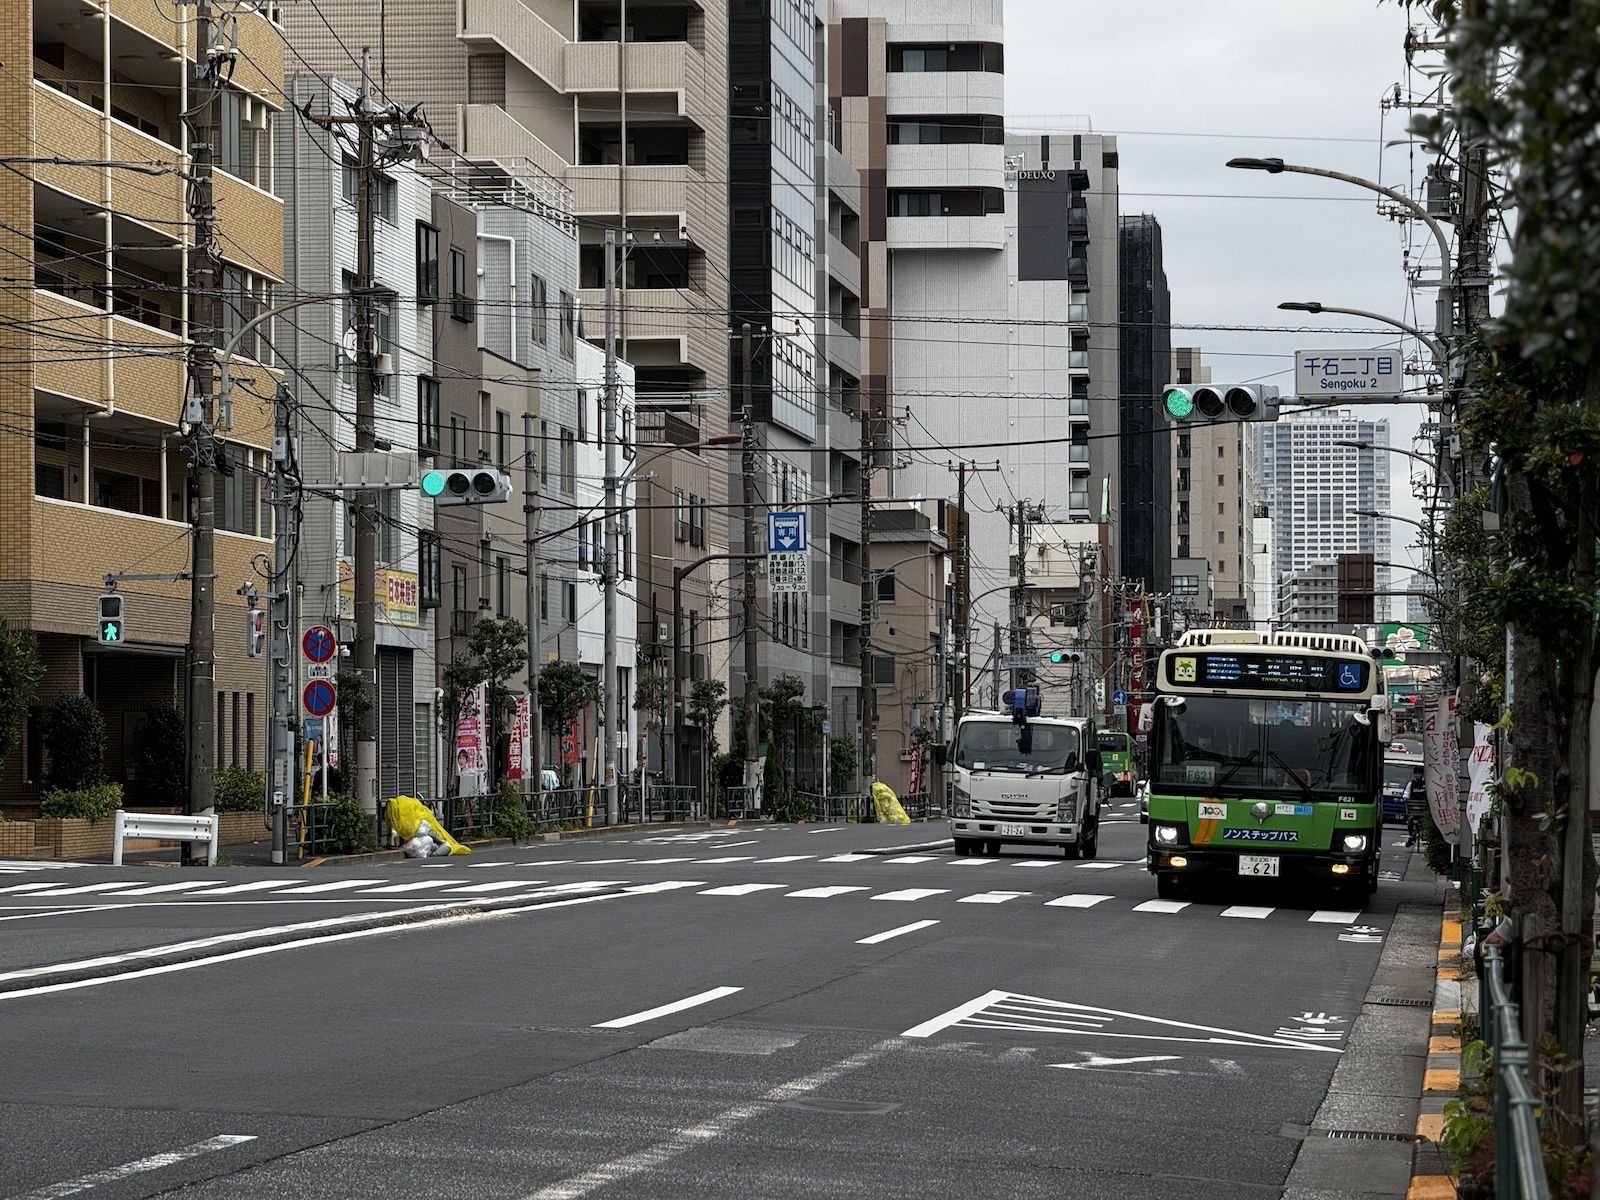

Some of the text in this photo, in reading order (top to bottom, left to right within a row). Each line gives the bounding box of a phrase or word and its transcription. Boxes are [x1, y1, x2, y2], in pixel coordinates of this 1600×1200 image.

[1019, 171, 1056, 181] DEUXQ
[1304, 357, 1392, 376] 千石二丁目
[1320, 378, 1377, 390] Sengoku 2
[1188, 770, 1213, 781] F621
[1224, 829, 1298, 841] ノンステップバス
